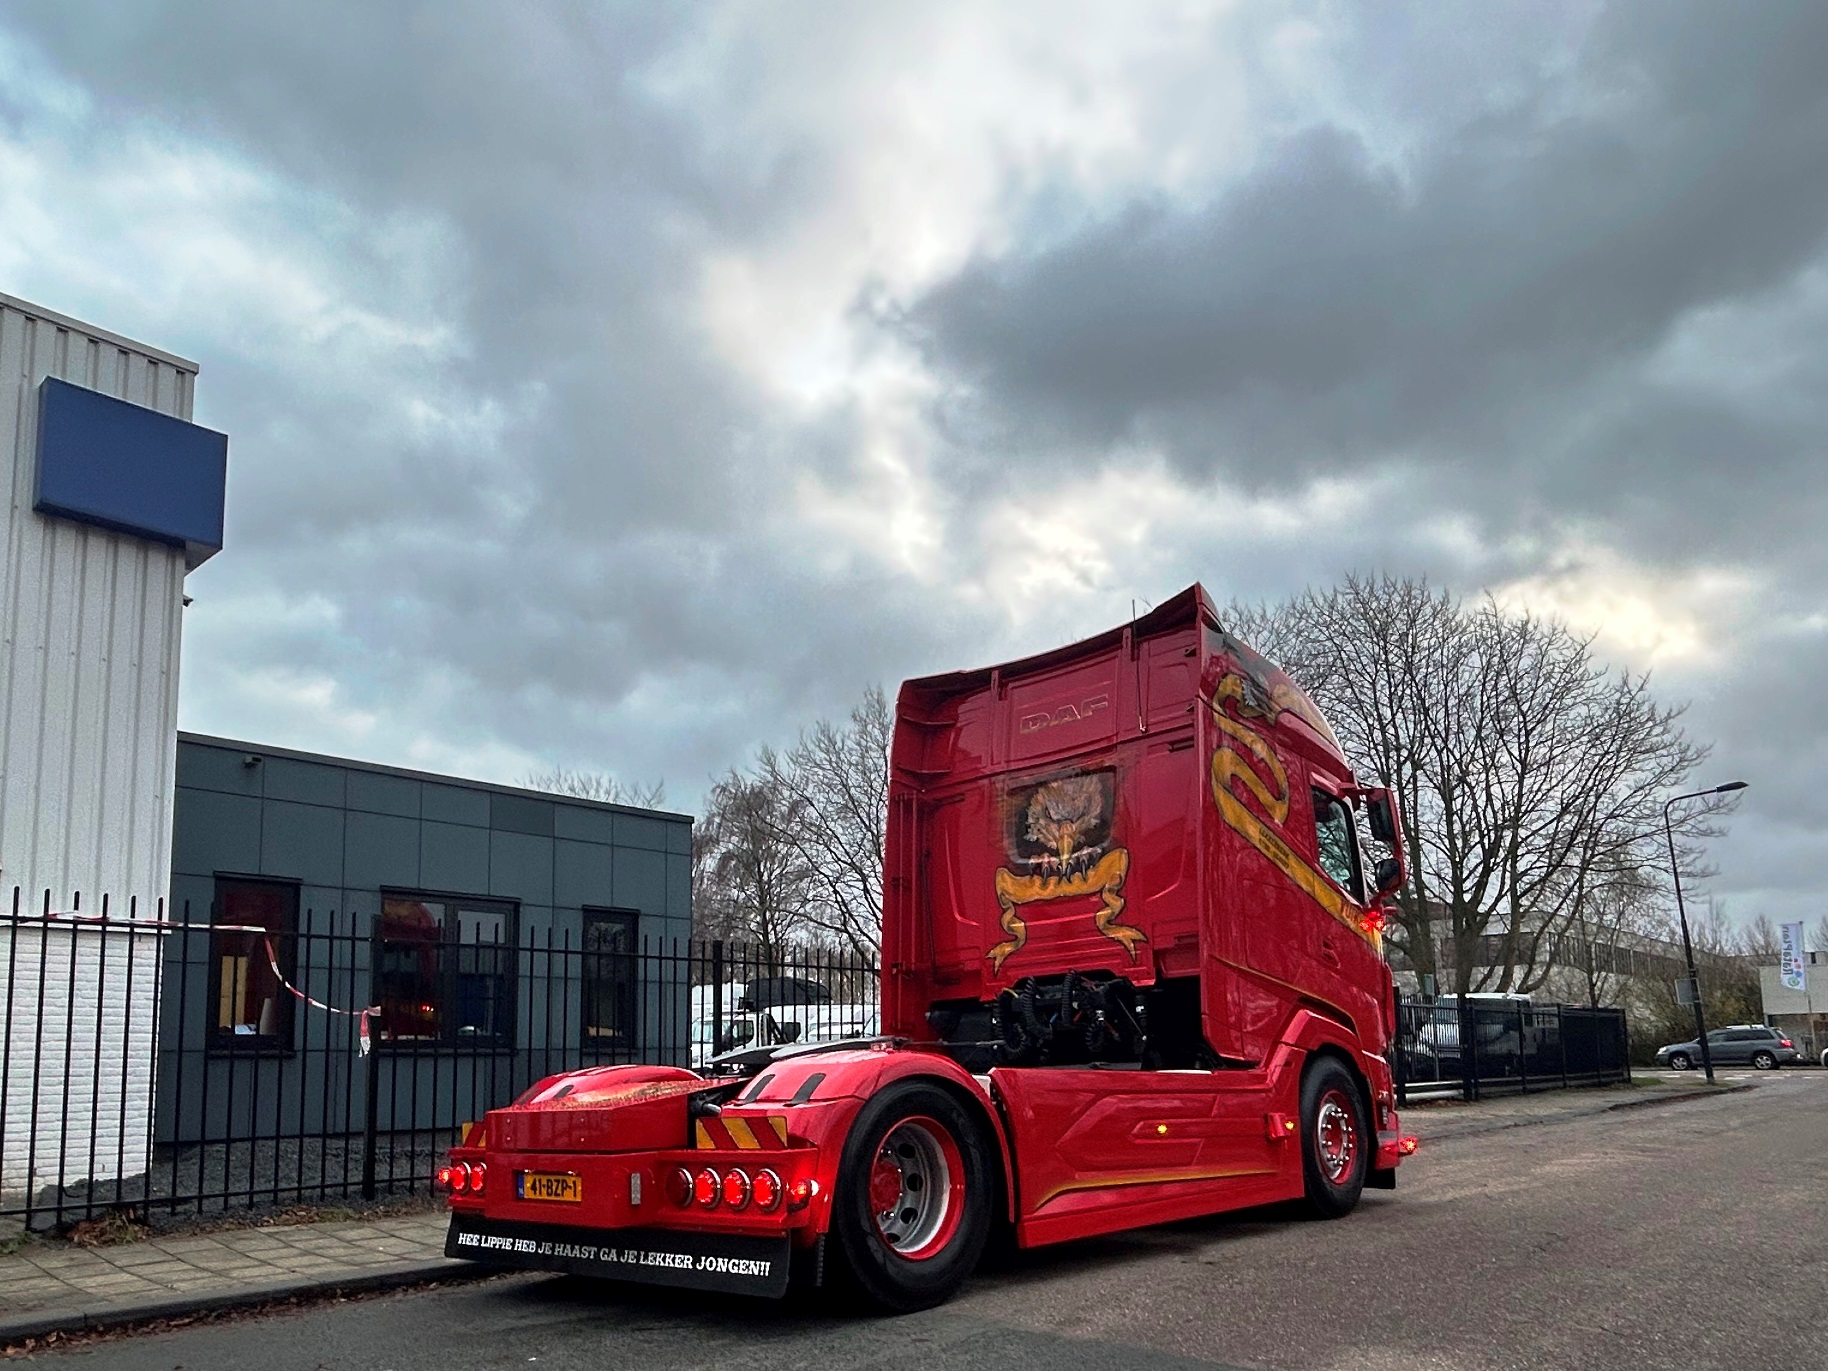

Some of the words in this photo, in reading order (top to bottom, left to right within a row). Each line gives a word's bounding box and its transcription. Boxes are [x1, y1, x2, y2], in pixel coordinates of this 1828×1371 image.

[1020, 694, 1108, 733] DAF
[530, 1178, 577, 1198] 41-BZP-1
[458, 1232, 480, 1246] HEE
[481, 1235, 513, 1250] LIPPIE
[514, 1238, 537, 1253] HEB
[538, 1241, 553, 1254] JE
[554, 1243, 598, 1259] HAAST
[600, 1247, 618, 1262] GA
[620, 1249, 637, 1264] JE
[639, 1250, 693, 1269] LEKKER
[696, 1256, 771, 1276] JONGEN!!
